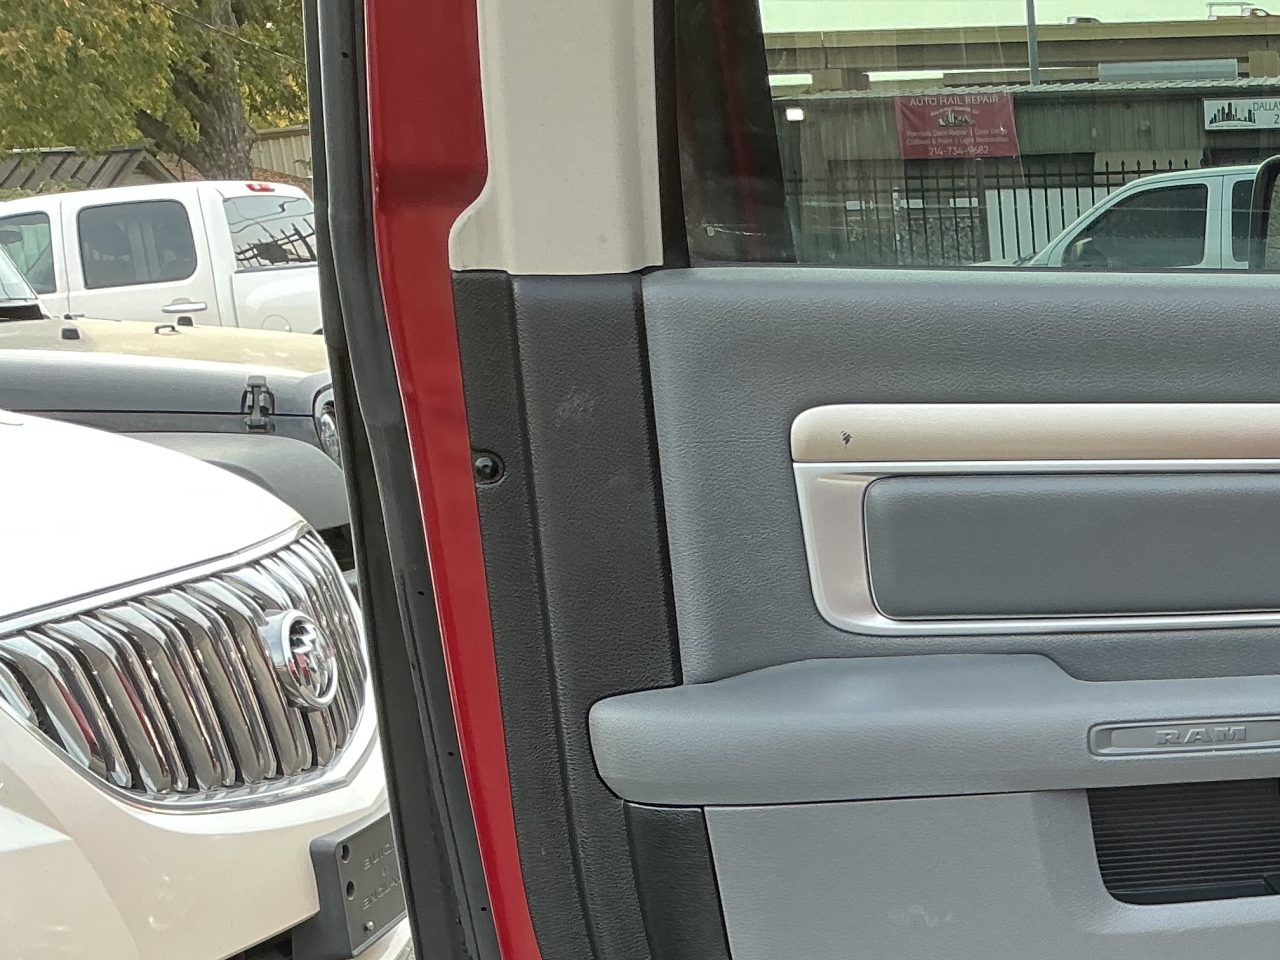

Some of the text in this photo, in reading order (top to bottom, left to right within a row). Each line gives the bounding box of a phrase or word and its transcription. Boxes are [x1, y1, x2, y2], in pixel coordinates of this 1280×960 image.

[909, 95, 999, 106] AUTO HAIL REPAIR
[928, 145, 989, 156] 214-734-9682
[1155, 726, 1247, 745] RAM
